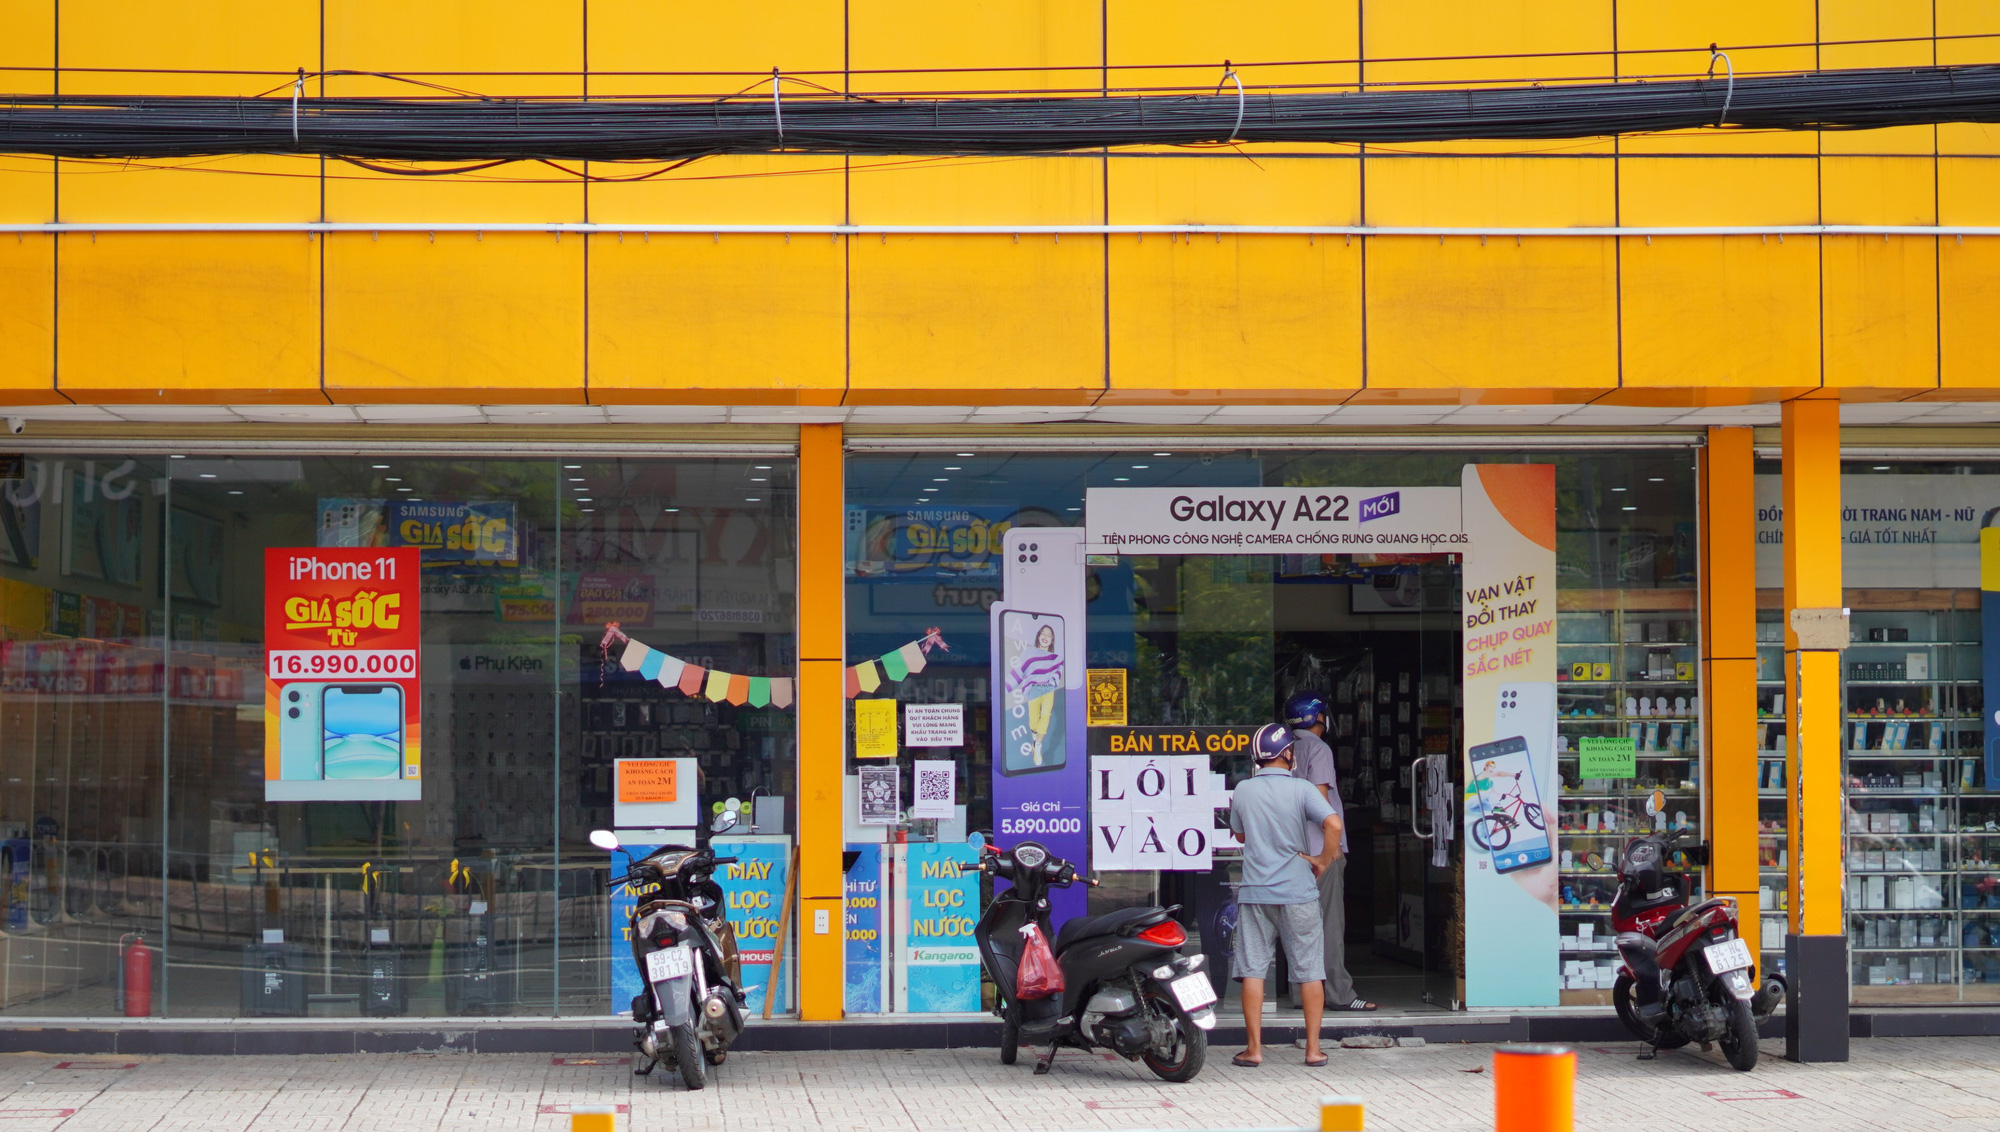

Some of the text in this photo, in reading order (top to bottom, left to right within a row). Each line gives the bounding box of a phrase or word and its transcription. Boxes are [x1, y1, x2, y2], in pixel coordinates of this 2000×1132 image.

[401, 505, 464, 517] SAMSUNG
[907, 510, 970, 521] SAMSUNG
[1170, 494, 1395, 530] Galaxy A22 MỚI
[1758, 504, 1783, 521] ĐỒN
[1861, 508, 1907, 521] TRANG
[1911, 508, 1942, 521] NAM
[1955, 505, 1975, 521] NỮ
[401, 514, 506, 552] GIÁ SỐC
[907, 518, 1011, 554] GIÁ SỐC
[1102, 530, 1468, 547] TIÊN PHONG CÔNG NGHỆ CAMERA CHỐNG RUNG QUANG HỌC OIS
[1850, 528, 1869, 544] GIÁ
[1875, 526, 1899, 544] TỐT
[1903, 527, 1937, 544] NHẤT
[290, 556, 396, 580] iPhone 11
[421, 584, 450, 595] alaxy
[1466, 575, 1535, 605] VẠN VẬT
[285, 590, 400, 629] GIÁ SỐC
[1466, 599, 1537, 628] ĐỔI THAY
[1466, 619, 1553, 652] CHỤP QUAY
[273, 654, 415, 674] 16.990.000
[475, 655, 543, 674] Phụ Kiện
[1467, 647, 1533, 676] SẮC NÉT
[1110, 730, 1250, 752] BÁN TRẢ GÓP
[1616, 754, 1631, 762] 2M
[657, 777, 671, 785] 2M
[1098, 759, 1198, 800] LỐI
[1021, 801, 1060, 812] Giá Chỉ
[1001, 818, 1081, 834] 5.890.000
[1099, 816, 1206, 857] VÀO
[728, 858, 773, 880] MÁY
[921, 857, 967, 879] MÁY
[846, 879, 876, 892] HỈ TỪ
[729, 890, 770, 914] LỌC
[923, 889, 964, 912] LỌC
[913, 915, 975, 937] NƯỚC
[653, 950, 683, 966] 59-C2
[1711, 942, 1740, 959] 54-H4
[651, 961, 689, 979] 381.19
[1716, 953, 1746, 970] 6125
